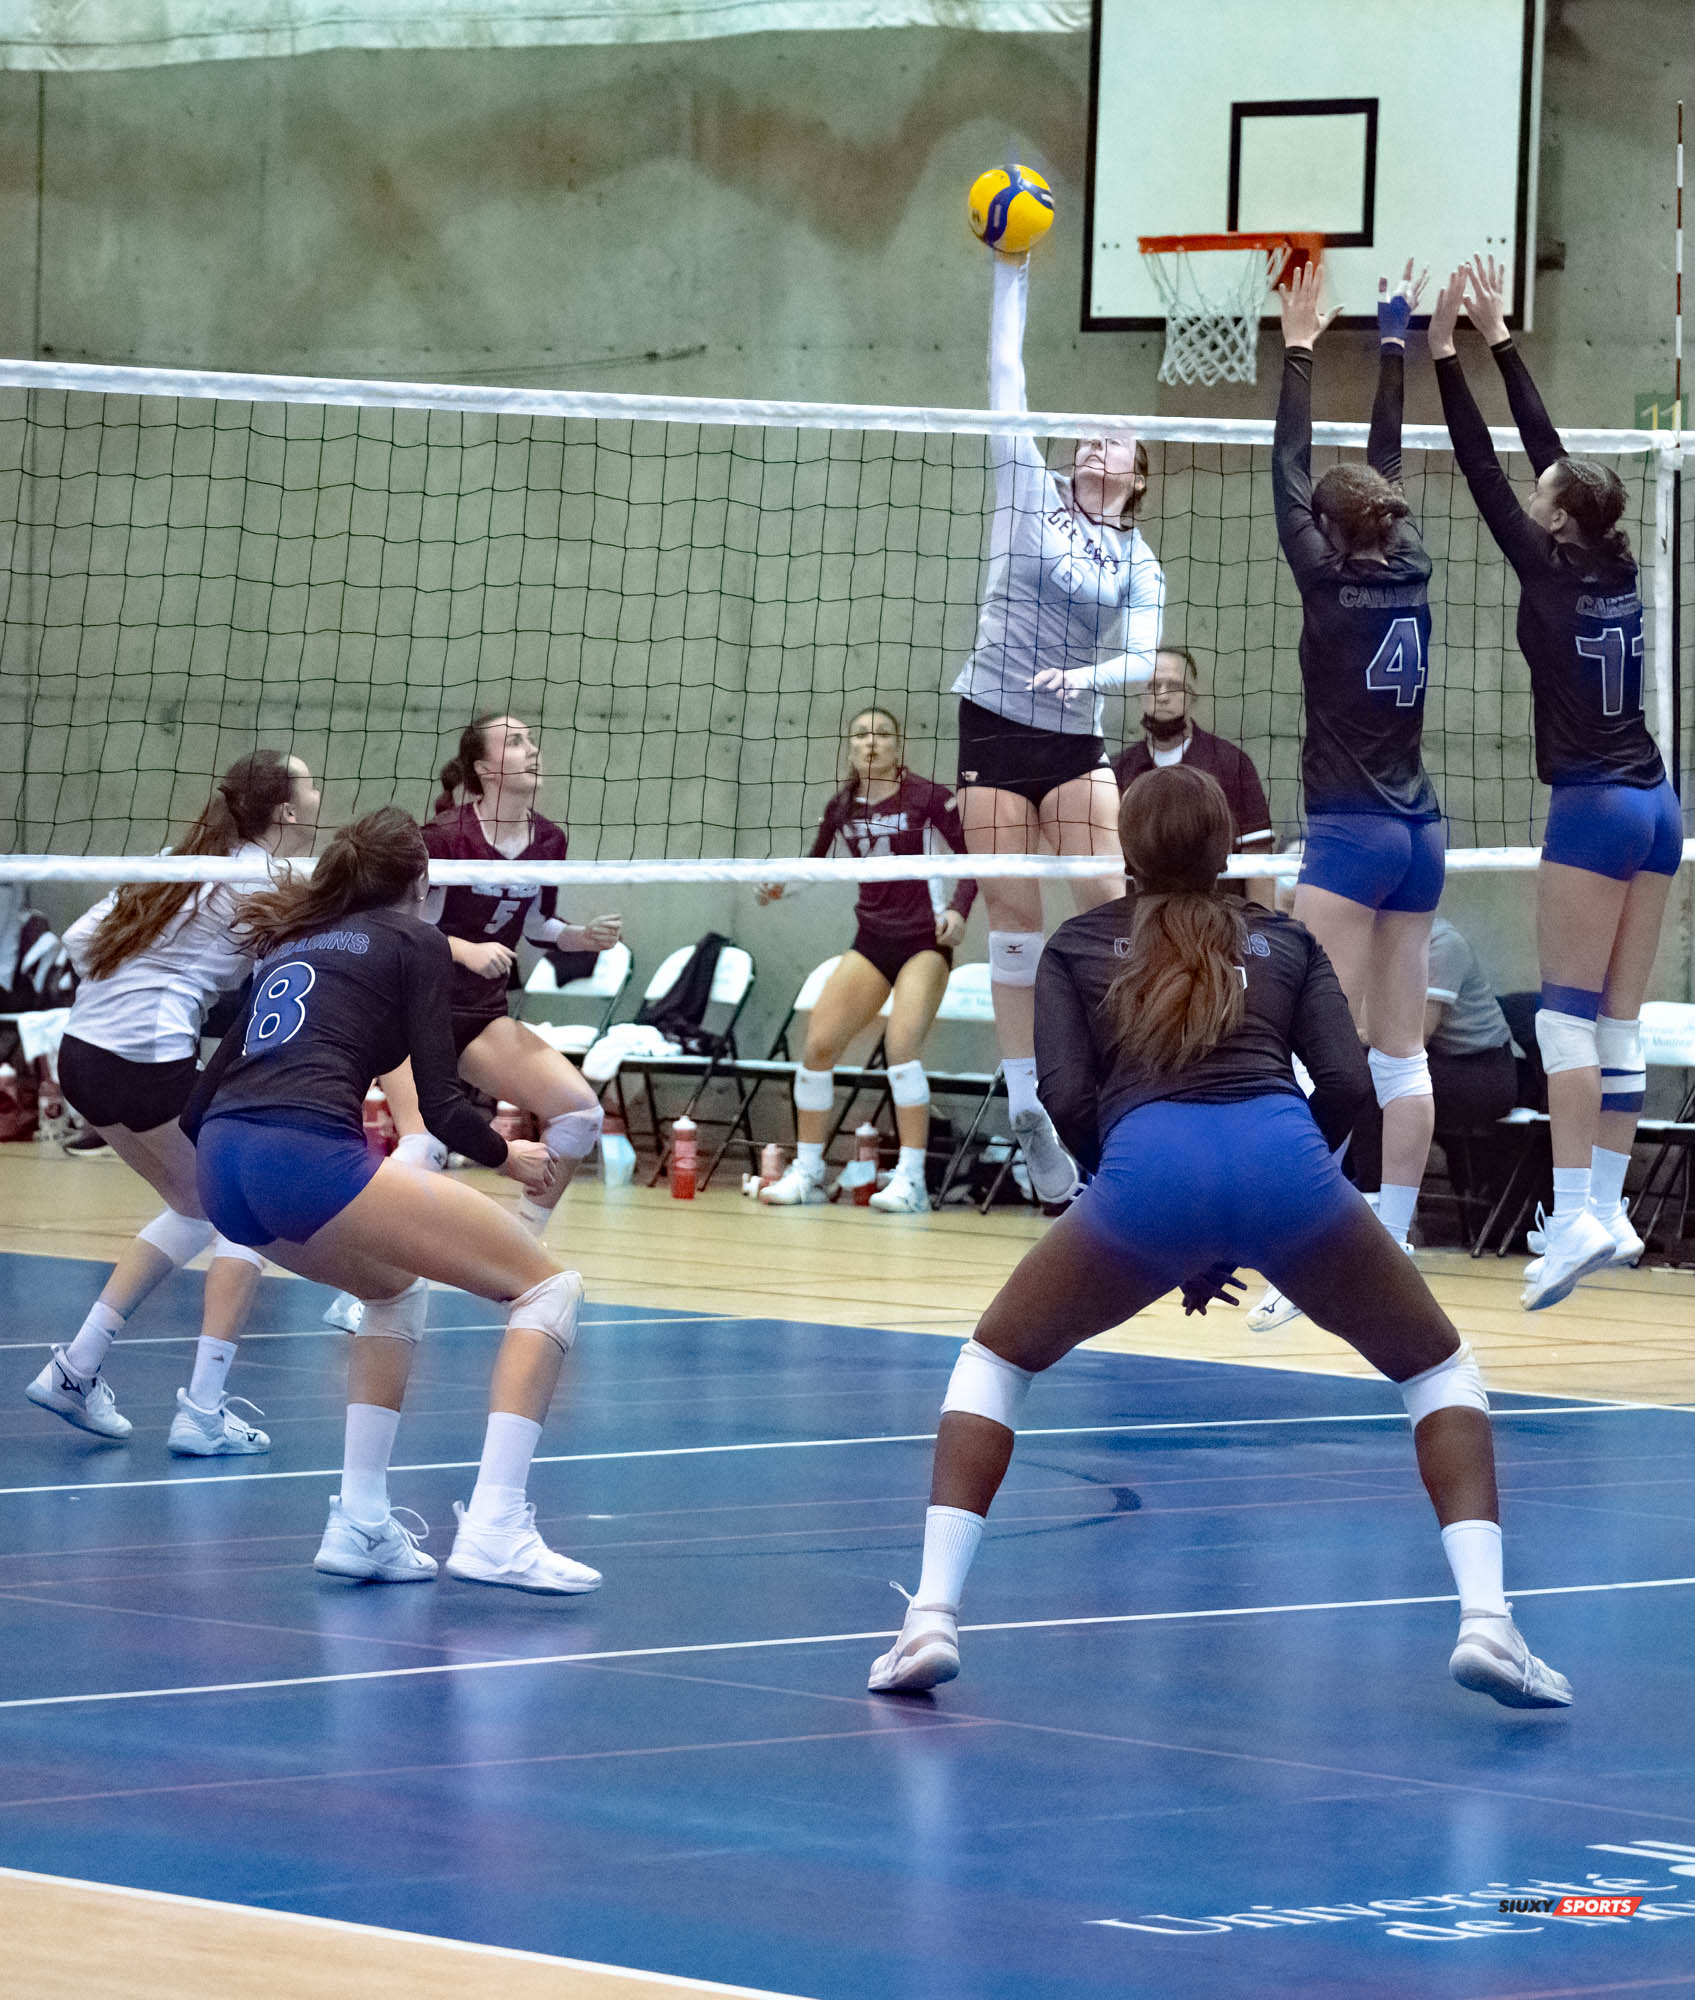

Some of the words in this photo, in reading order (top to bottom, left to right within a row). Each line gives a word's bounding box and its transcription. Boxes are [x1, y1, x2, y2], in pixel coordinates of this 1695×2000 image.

[1366, 616, 1426, 707] 4
[483, 899, 521, 935] 5
[241, 961, 316, 1056] 8
[1083, 1873, 1678, 1935] Université
[1378, 1919, 1545, 1942] de
